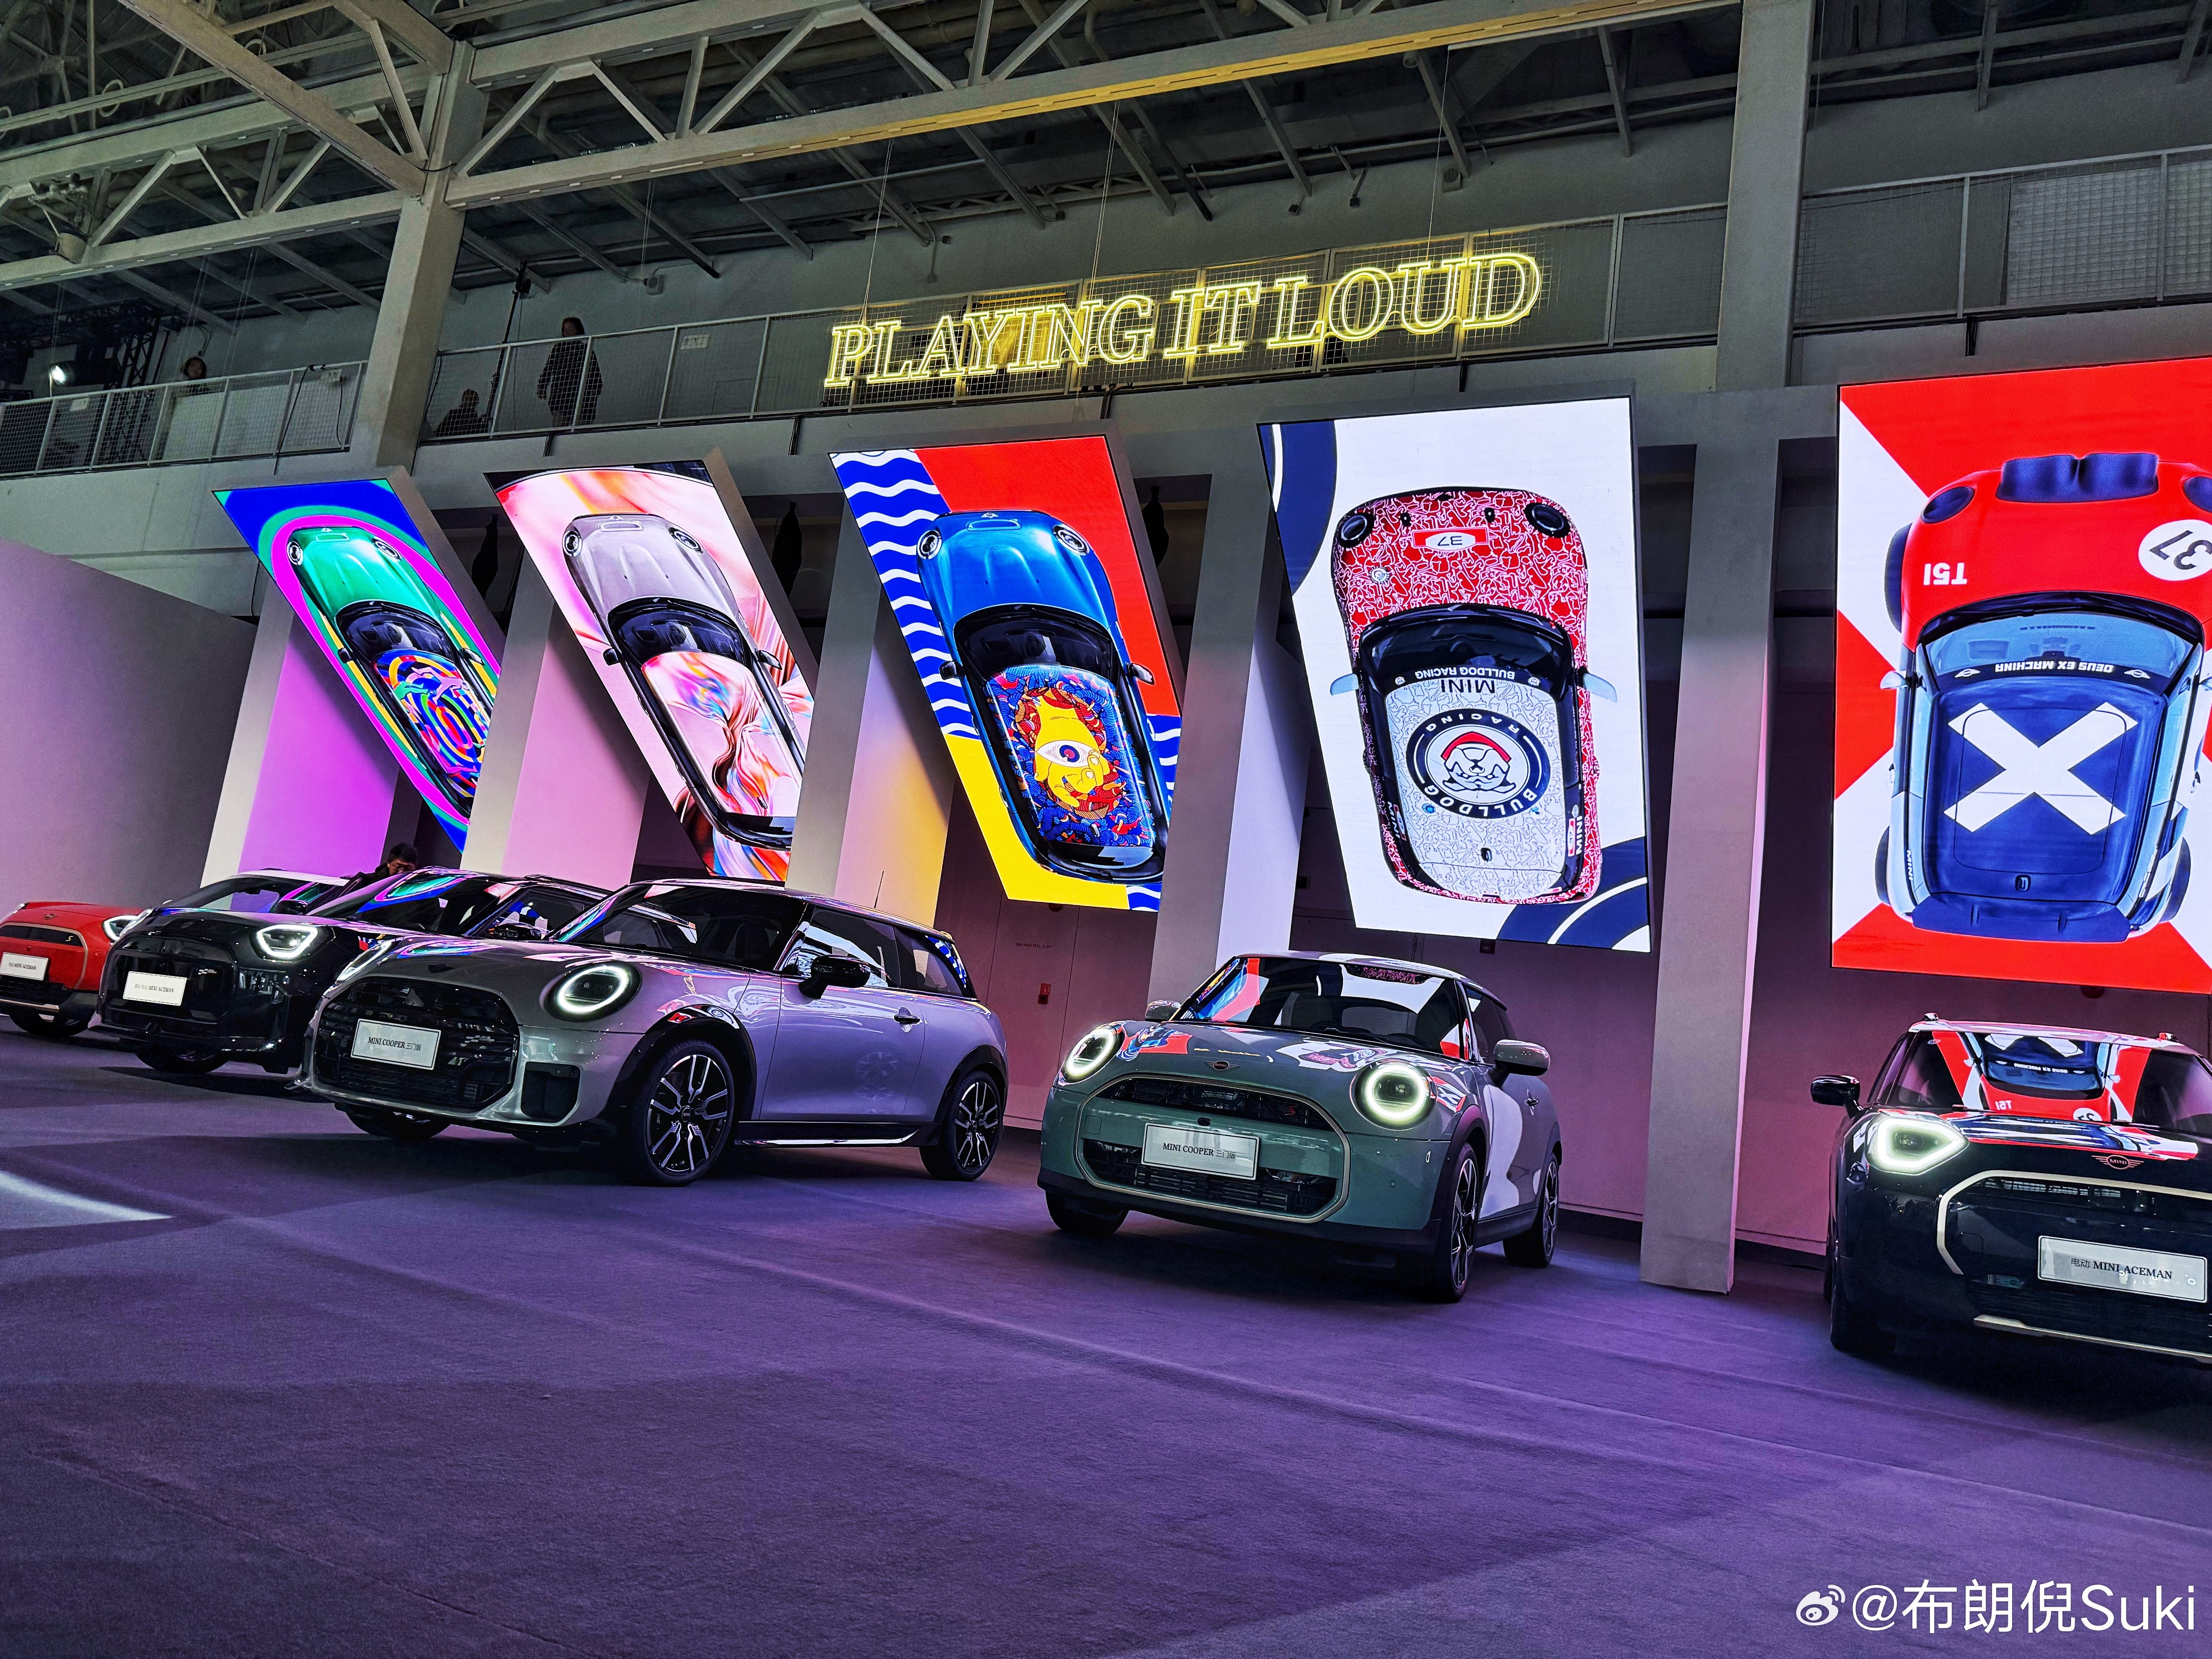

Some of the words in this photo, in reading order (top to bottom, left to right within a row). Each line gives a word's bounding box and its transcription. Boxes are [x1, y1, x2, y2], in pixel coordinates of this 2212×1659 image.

[824, 294, 1155, 387] PLAYING
[1163, 281, 1262, 358] IT
[1266, 252, 1543, 348] LOUD
[1438, 536, 1463, 546] 37
[2149, 530, 2212, 570] 37
[1415, 666, 1457, 679] RACING
[1995, 661, 2053, 672] MACHINA
[2057, 661, 2076, 670] EX
[2078, 662, 2114, 673] DEUS
[1460, 667, 1515, 680] BULLDOG
[1441, 679, 1495, 694] MINI
[1426, 713, 1520, 734] RACING
[1424, 785, 1537, 817] BULLDOG
[1388, 801, 1400, 838] MINI
[368, 1037, 381, 1045] MINI
[383, 1039, 405, 1048] COOPER
[1163, 1142, 1181, 1151] MINI
[1183, 1145, 1214, 1156] COOPER
[1216, 1149, 1236, 1159] 三门版
[2071, 1258, 2090, 1268] 电动
[2093, 1261, 2120, 1272] MINI
[2124, 1265, 2173, 1279] ACEMAN
